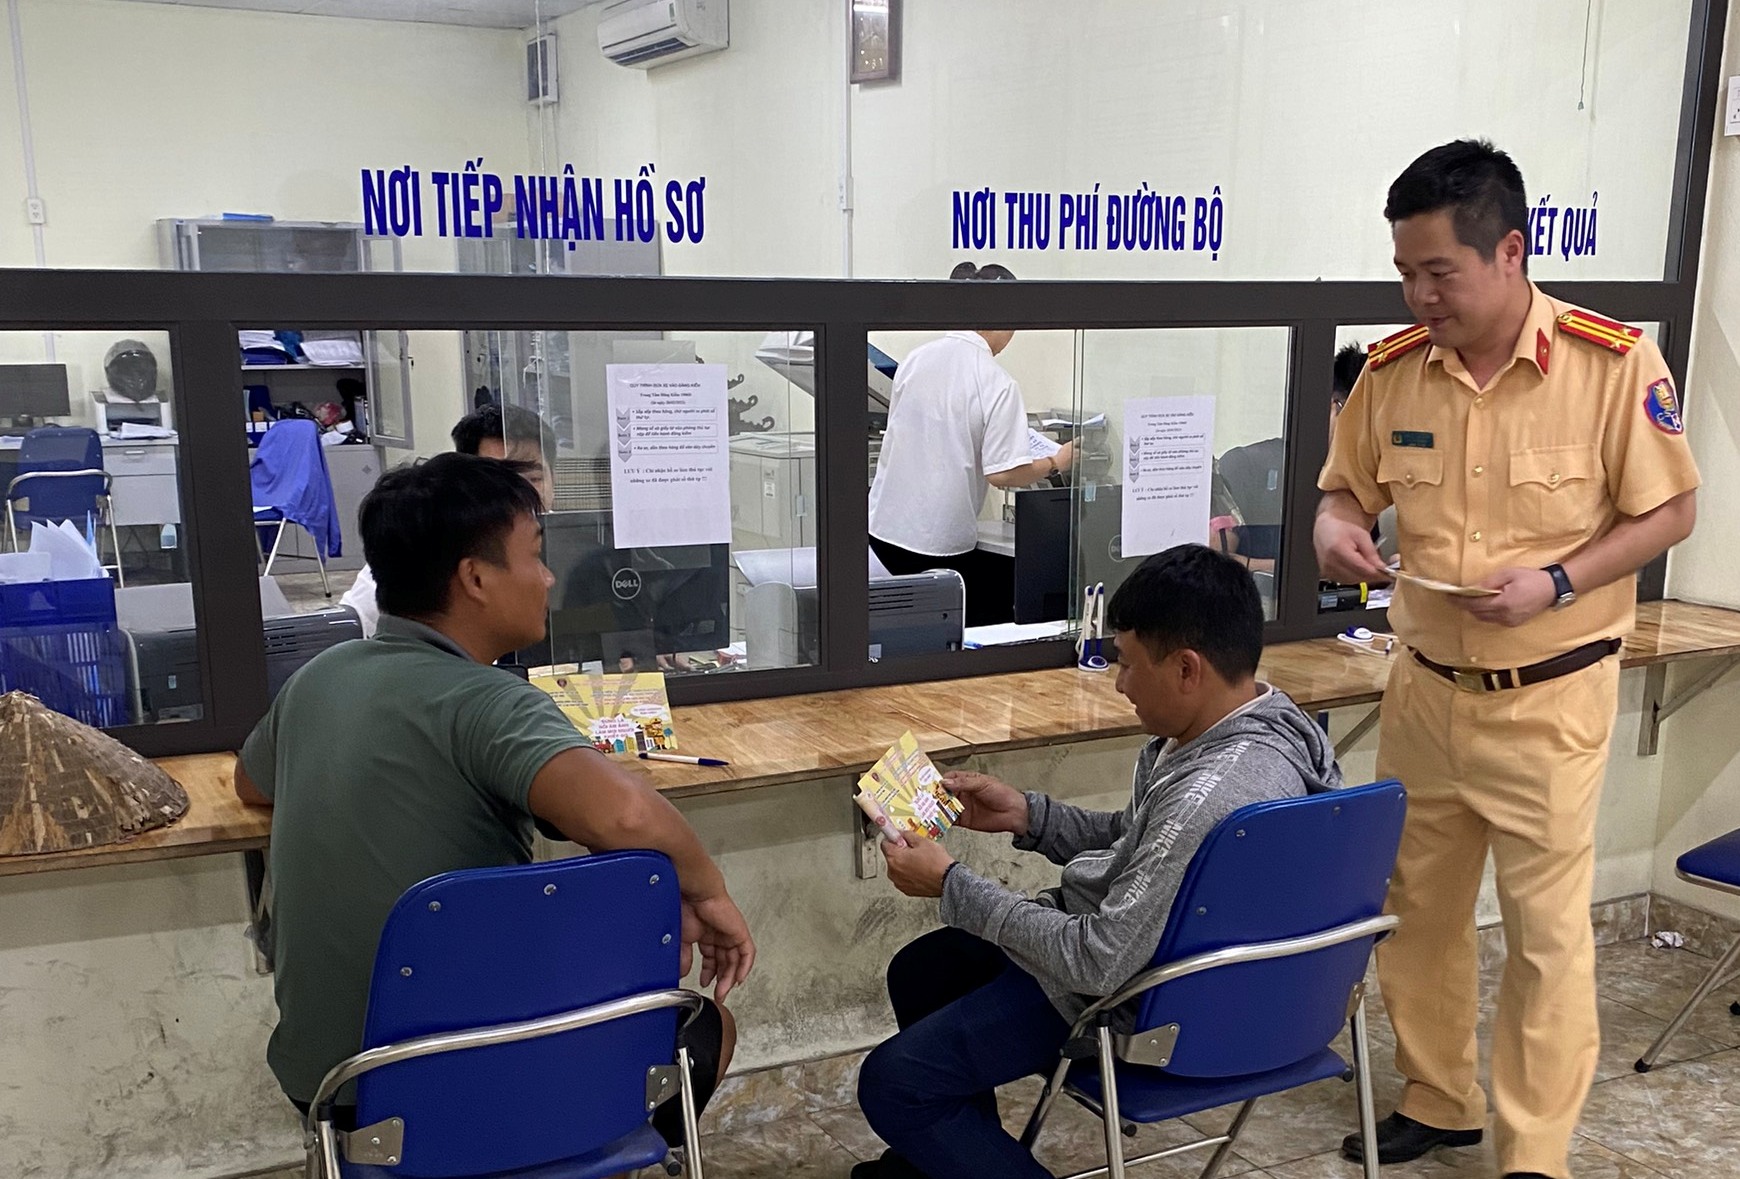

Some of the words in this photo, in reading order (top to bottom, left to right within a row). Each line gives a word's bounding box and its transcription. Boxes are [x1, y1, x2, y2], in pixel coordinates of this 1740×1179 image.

[361, 165, 423, 237] NƠI
[431, 157, 503, 239] TIẾP
[513, 163, 605, 251] NHẬN
[614, 163, 656, 243] HỒ
[665, 176, 706, 244] SƠ
[952, 187, 996, 250] NƠI
[1004, 192, 1051, 250] THU
[1059, 183, 1101, 250] PHÍ
[1106, 182, 1186, 251] ĐƯỜNG
[1193, 186, 1224, 261] BỘ
[1526, 194, 1558, 256] KẾT
[1561, 191, 1598, 262] QUẢ
[615, 579, 638, 589] DELL
[1216, 740, 1252, 763] NIKE
[1183, 773, 1222, 805] NIKE
[1151, 819, 1184, 858] NIKE
[1120, 869, 1151, 906] NIKE
